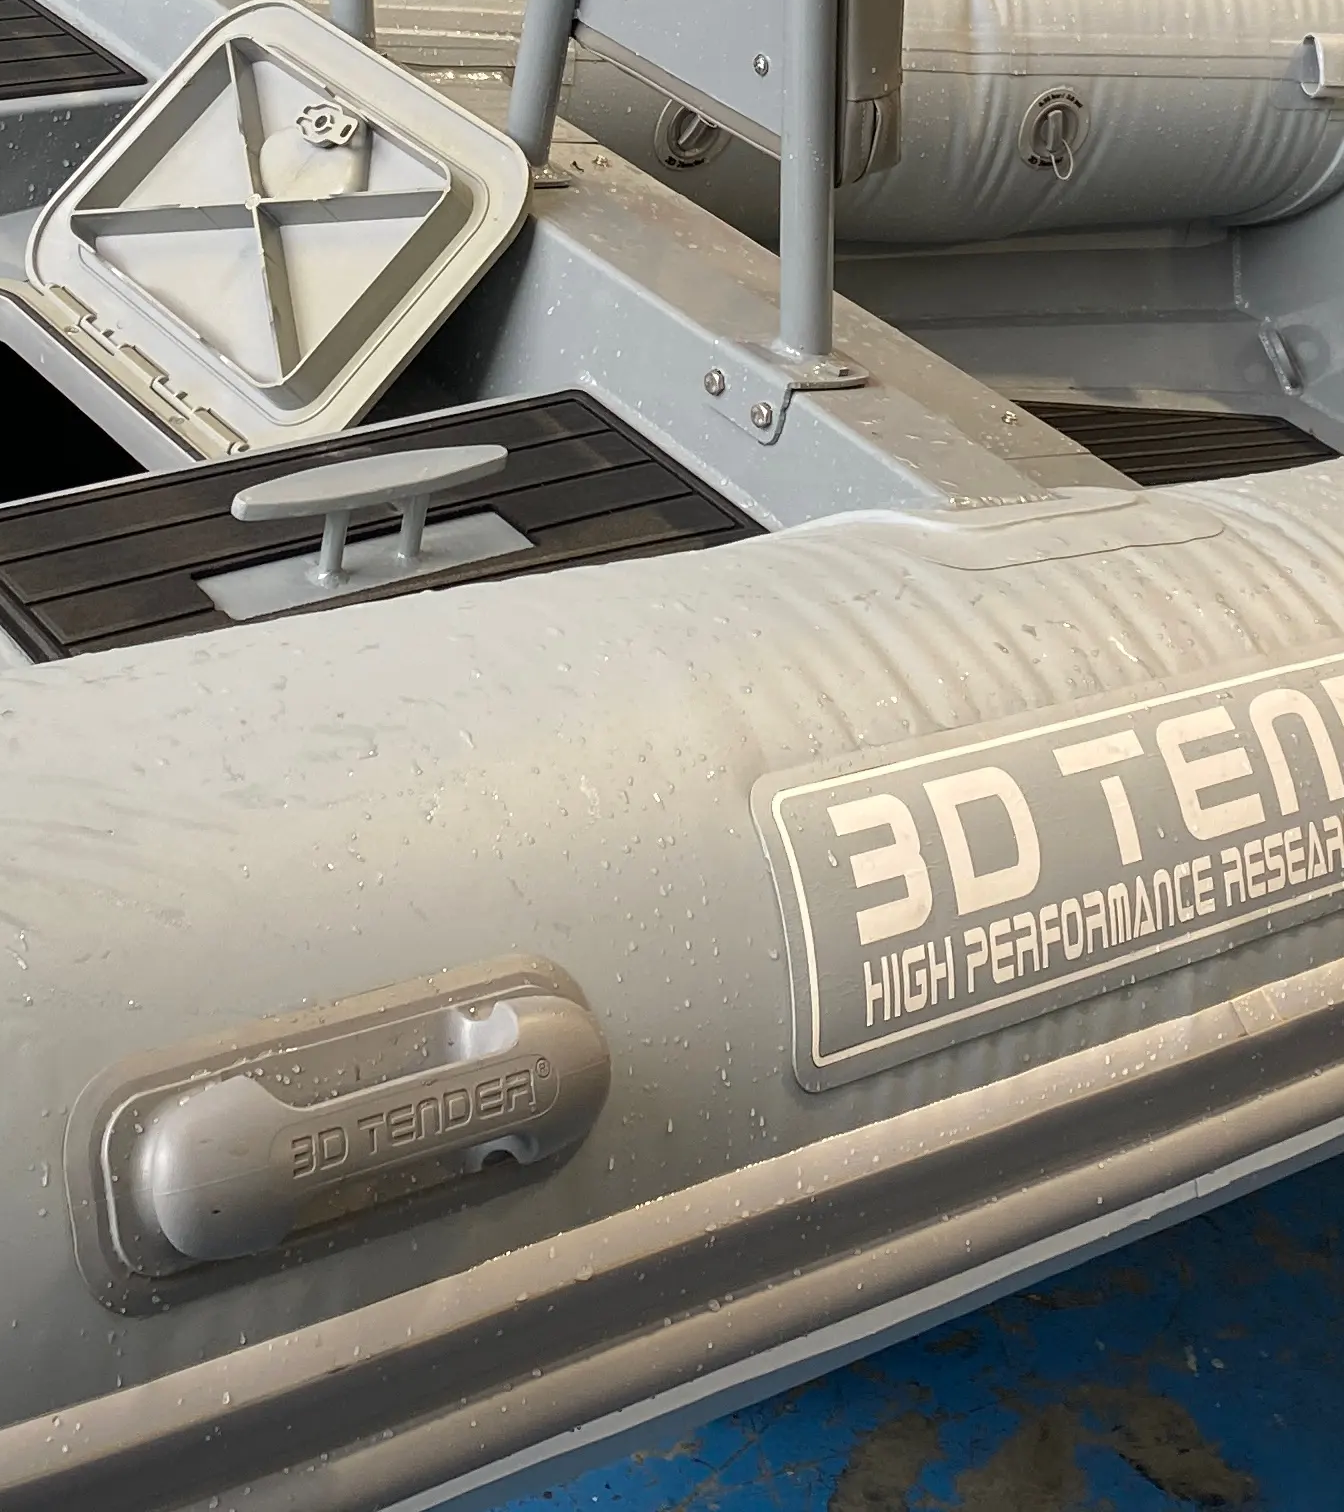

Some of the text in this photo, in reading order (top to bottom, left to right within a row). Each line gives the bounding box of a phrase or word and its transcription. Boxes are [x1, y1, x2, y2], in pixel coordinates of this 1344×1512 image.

[827, 767, 1040, 946] 3D
[864, 940, 956, 1028] HIGH
[965, 857, 1218, 994] PERFORMANCE
[291, 1068, 536, 1180] 3D TENDER
